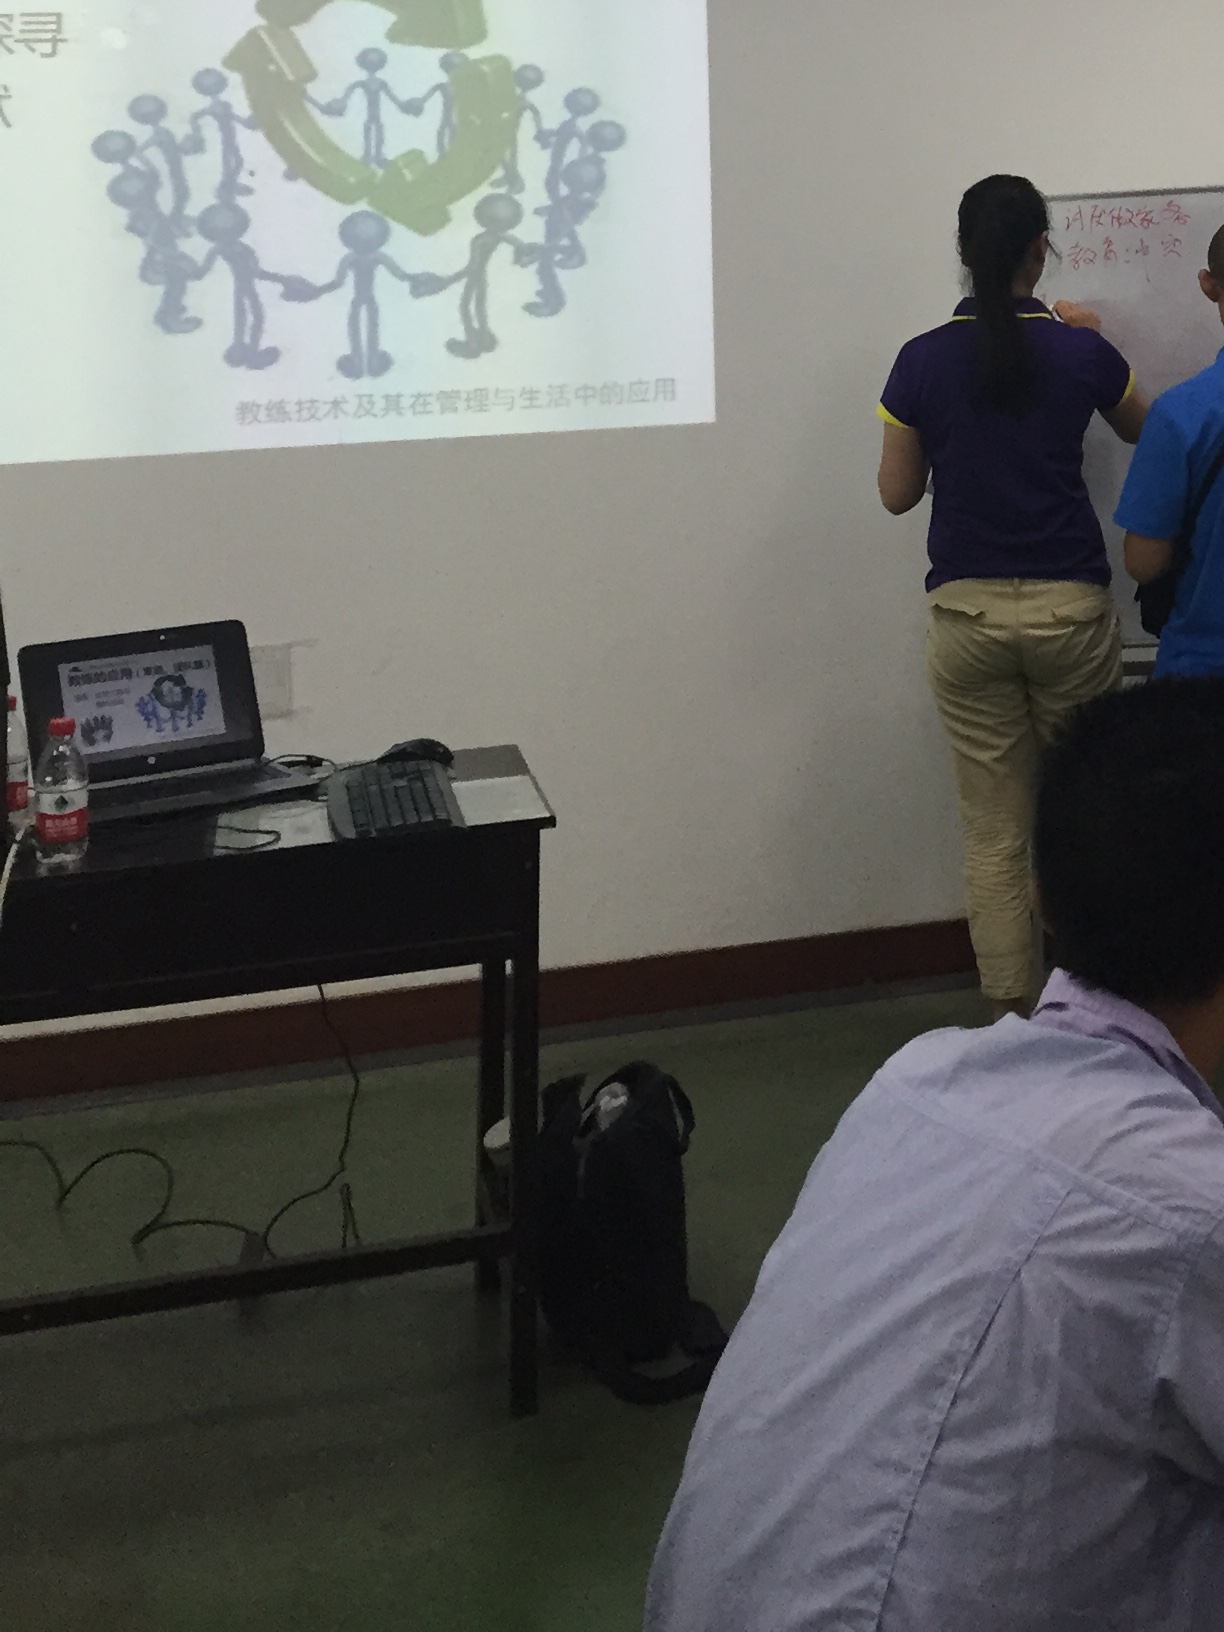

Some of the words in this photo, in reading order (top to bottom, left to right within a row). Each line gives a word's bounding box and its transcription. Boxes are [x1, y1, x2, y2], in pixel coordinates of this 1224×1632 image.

[236, 377, 676, 426] 教练技术及其在管理与生活中的应用
